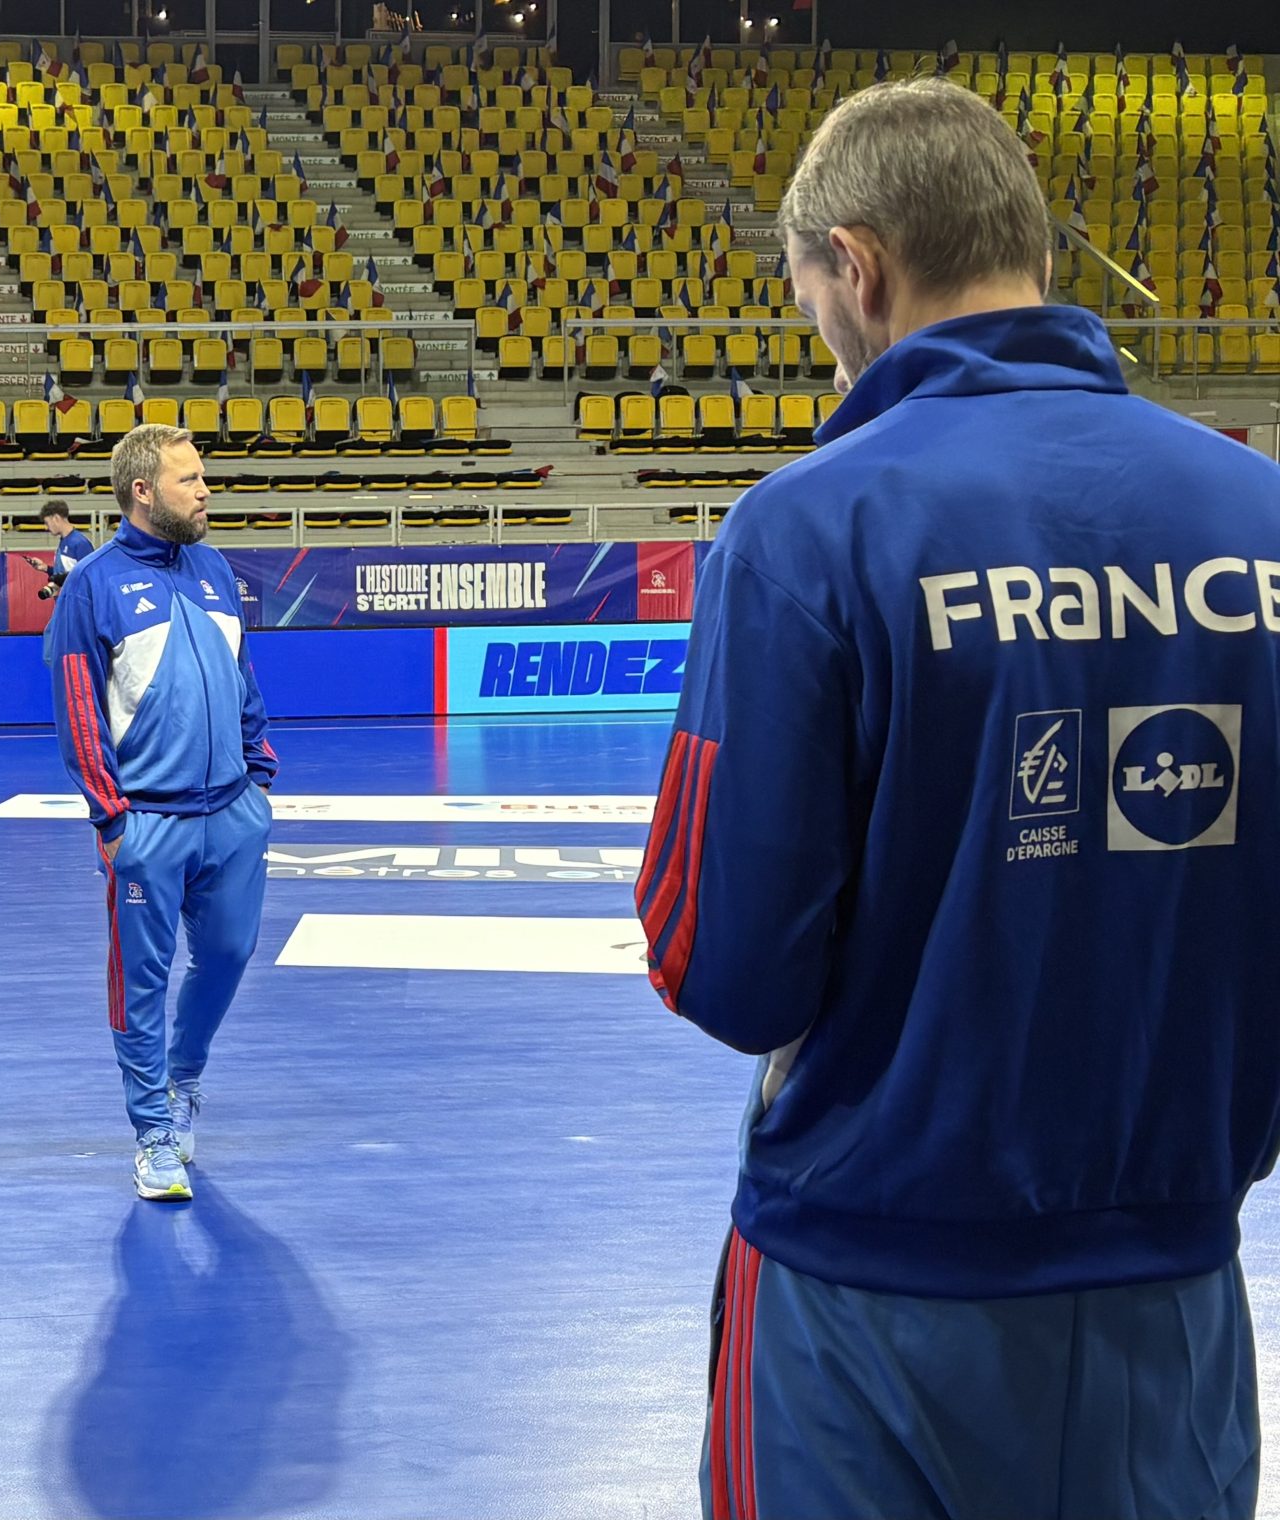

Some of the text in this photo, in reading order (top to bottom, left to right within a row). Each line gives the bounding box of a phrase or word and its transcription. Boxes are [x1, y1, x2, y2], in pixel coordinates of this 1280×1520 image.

[356, 564, 429, 594] L'HISTOIRE
[430, 562, 547, 611] ENSEMBLE
[356, 591, 429, 612] S'ÉCRIT
[1019, 826, 1067, 844] CAISSE
[1006, 840, 1079, 862] D'EPARGNE
